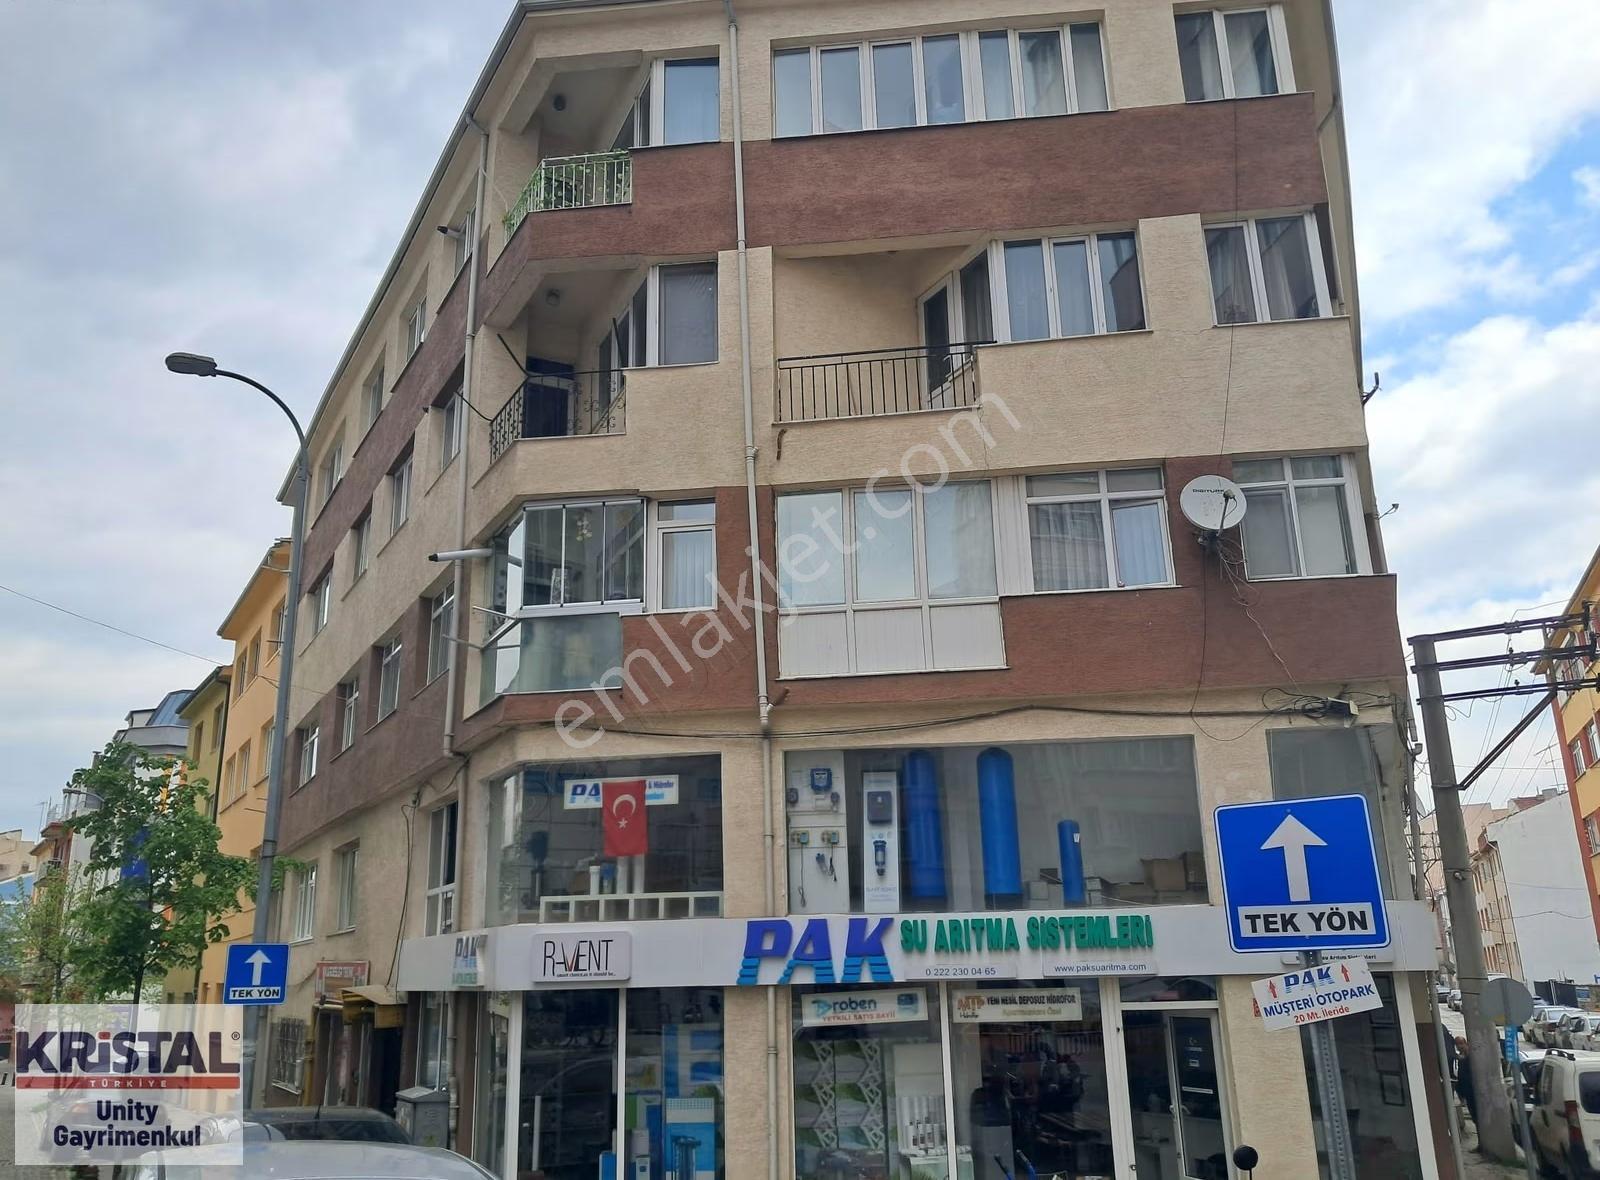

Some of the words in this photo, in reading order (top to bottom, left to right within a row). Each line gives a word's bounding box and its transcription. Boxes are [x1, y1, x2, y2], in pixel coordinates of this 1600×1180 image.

[1244, 912, 1301, 934] TEK
[1307, 907, 1368, 932] YÖN
[736, 917, 894, 986] PAK
[900, 919, 927, 952] SU
[934, 917, 1020, 953] ARITMA
[925, 968, 931, 976] 0
[934, 968, 950, 976] 222
[953, 967, 969, 976] 230
[971, 967, 982, 975] 04
[984, 967, 997, 975] 65
[1054, 963, 1147, 973] www.paksuaritma.com
[1283, 966, 1335, 993] PAK
[231, 989, 254, 998] TEK
[1018, 995, 1046, 1005] DEPOSUZ
[1263, 994, 1315, 1017] MÜŞTERİ
[1316, 984, 1375, 1006] OTOPARK
[1293, 1014, 1305, 1024] 20
[1306, 1011, 1321, 1021] Mt.
[1322, 1005, 1350, 1017] İleride
